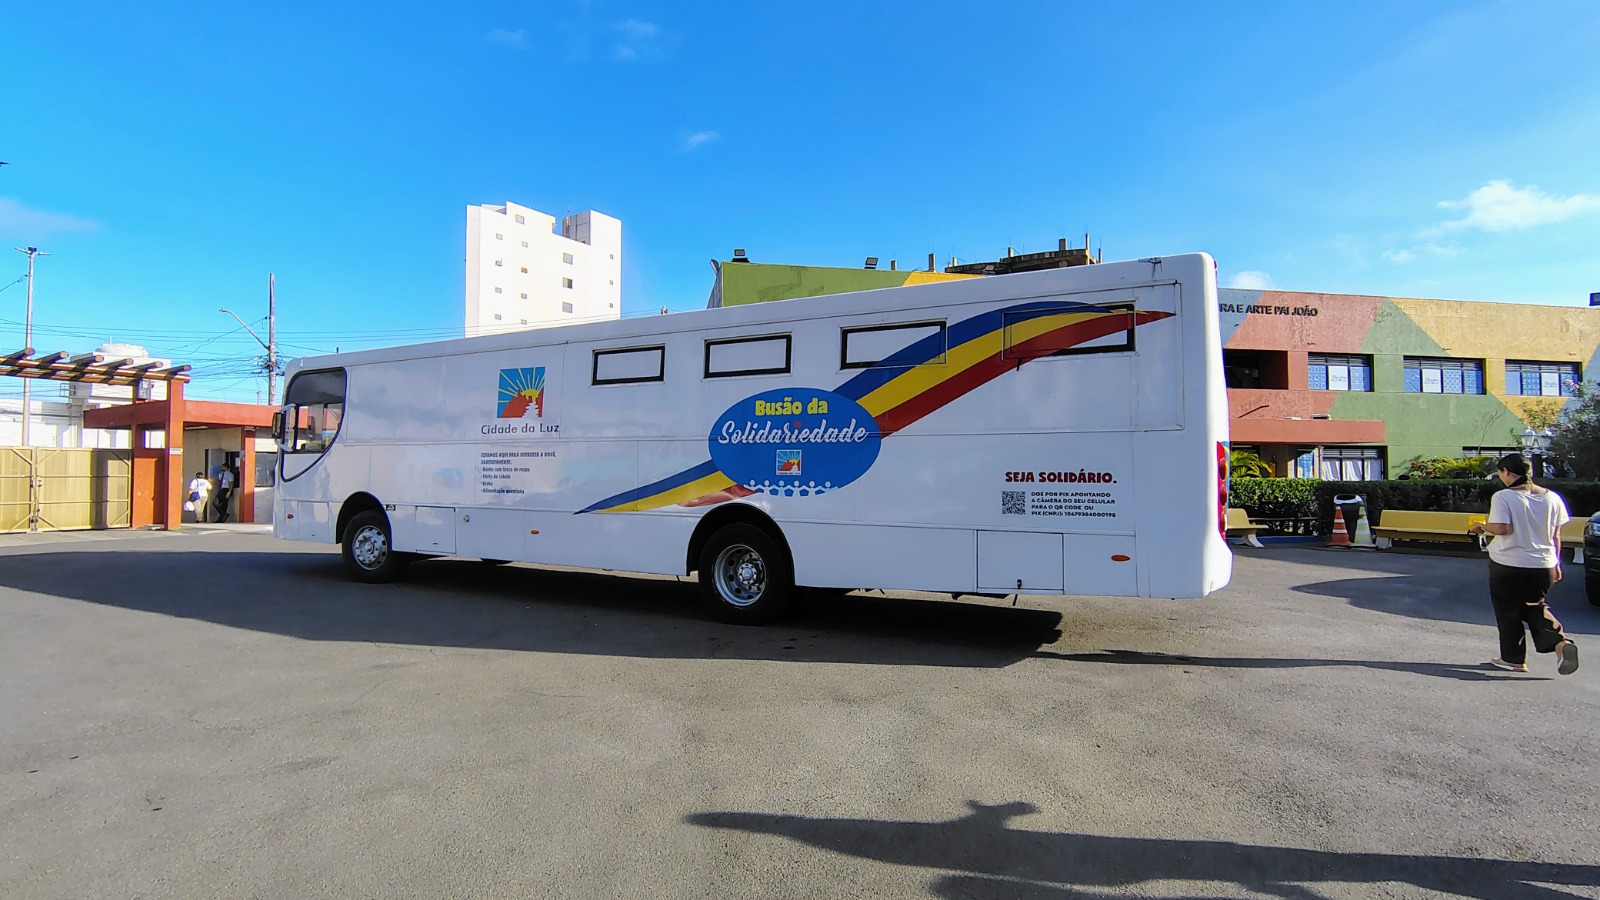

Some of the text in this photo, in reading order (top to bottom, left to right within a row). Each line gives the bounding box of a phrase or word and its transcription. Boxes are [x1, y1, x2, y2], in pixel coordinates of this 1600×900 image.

[1219, 303, 1319, 317] RA E ARTE PAI JOÃO
[755, 396, 828, 416] Busão da
[481, 423, 560, 435] Cidade da Luz
[718, 418, 869, 444] Solidariedade
[1005, 468, 1118, 484] SEJA SOLIDÁRIO.
